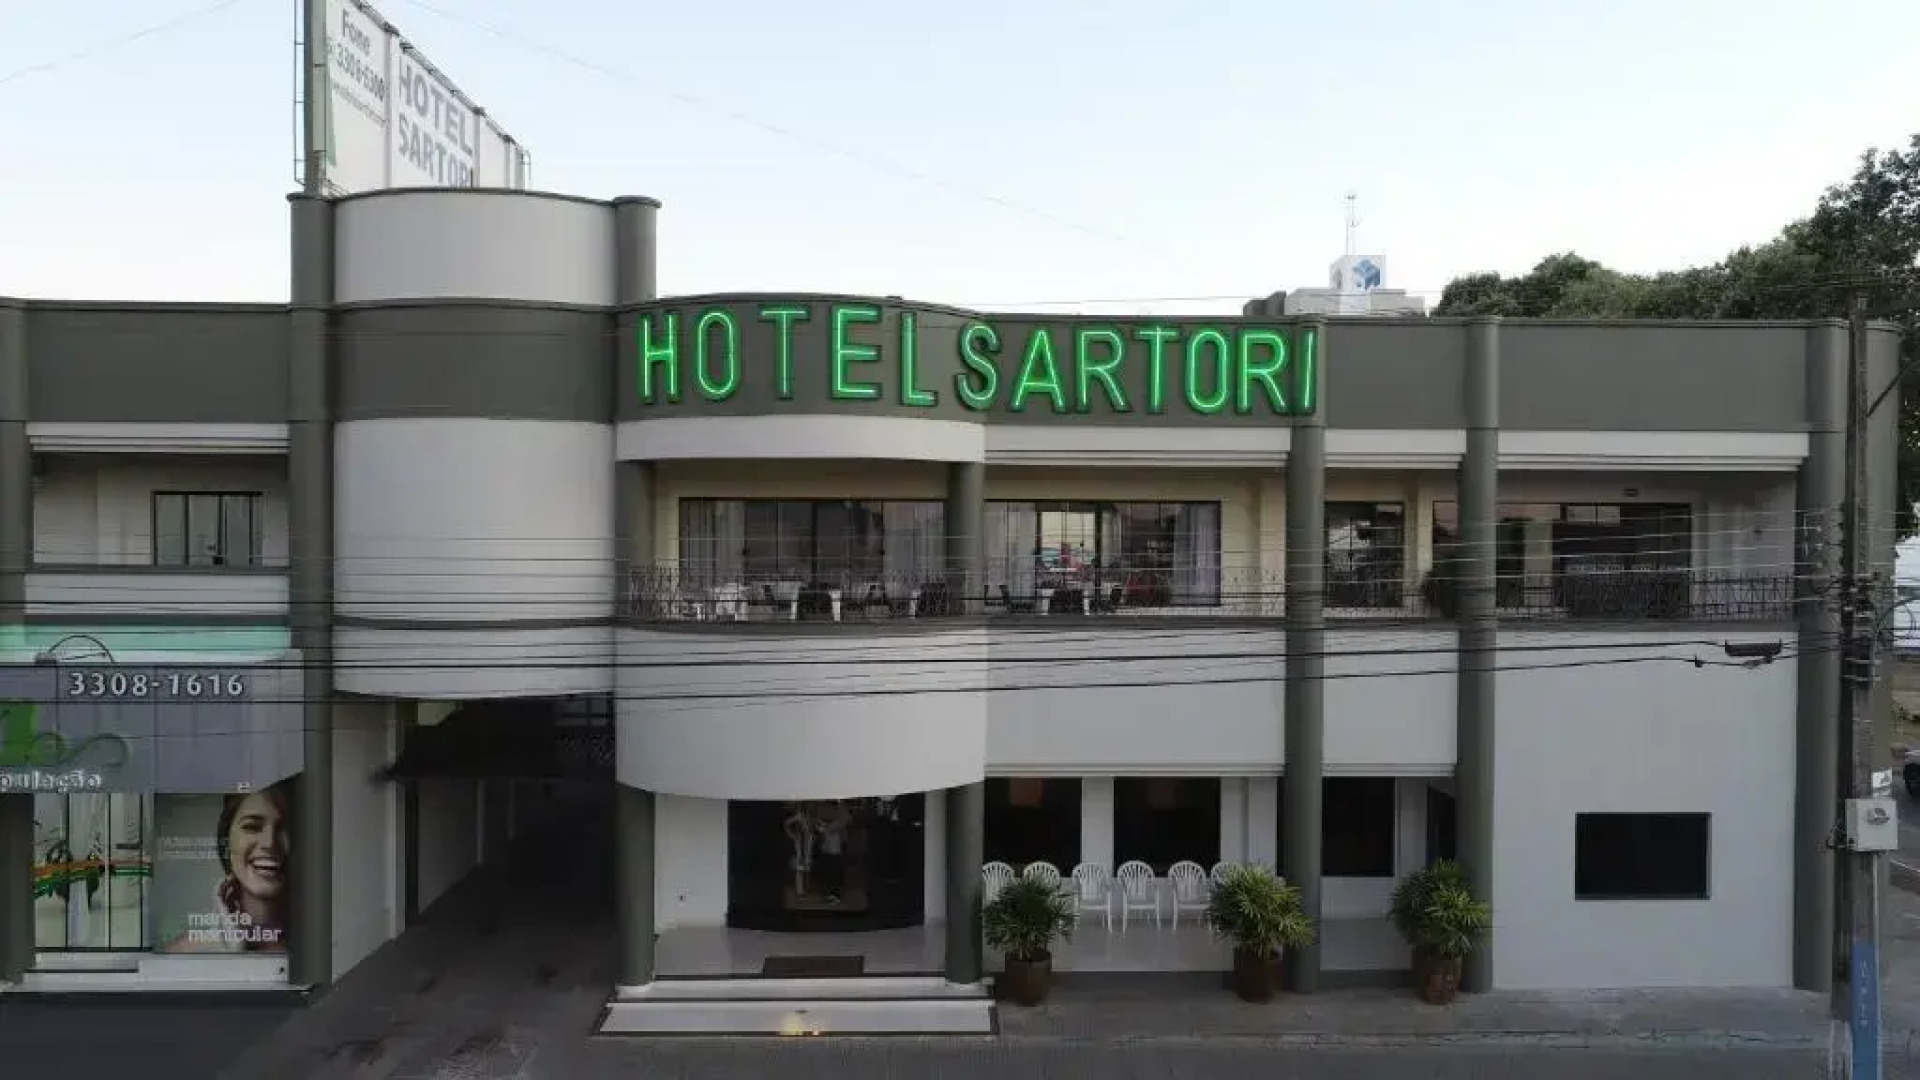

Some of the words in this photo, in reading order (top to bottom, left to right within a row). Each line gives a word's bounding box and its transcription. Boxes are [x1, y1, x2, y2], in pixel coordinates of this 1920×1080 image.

[342, 8, 370, 57] Fone
[398, 54, 474, 158] HOTEL
[637, 305, 939, 407] HOTEL
[956, 322, 1319, 415] SARTORI
[68, 671, 245, 698] 3308-1616
